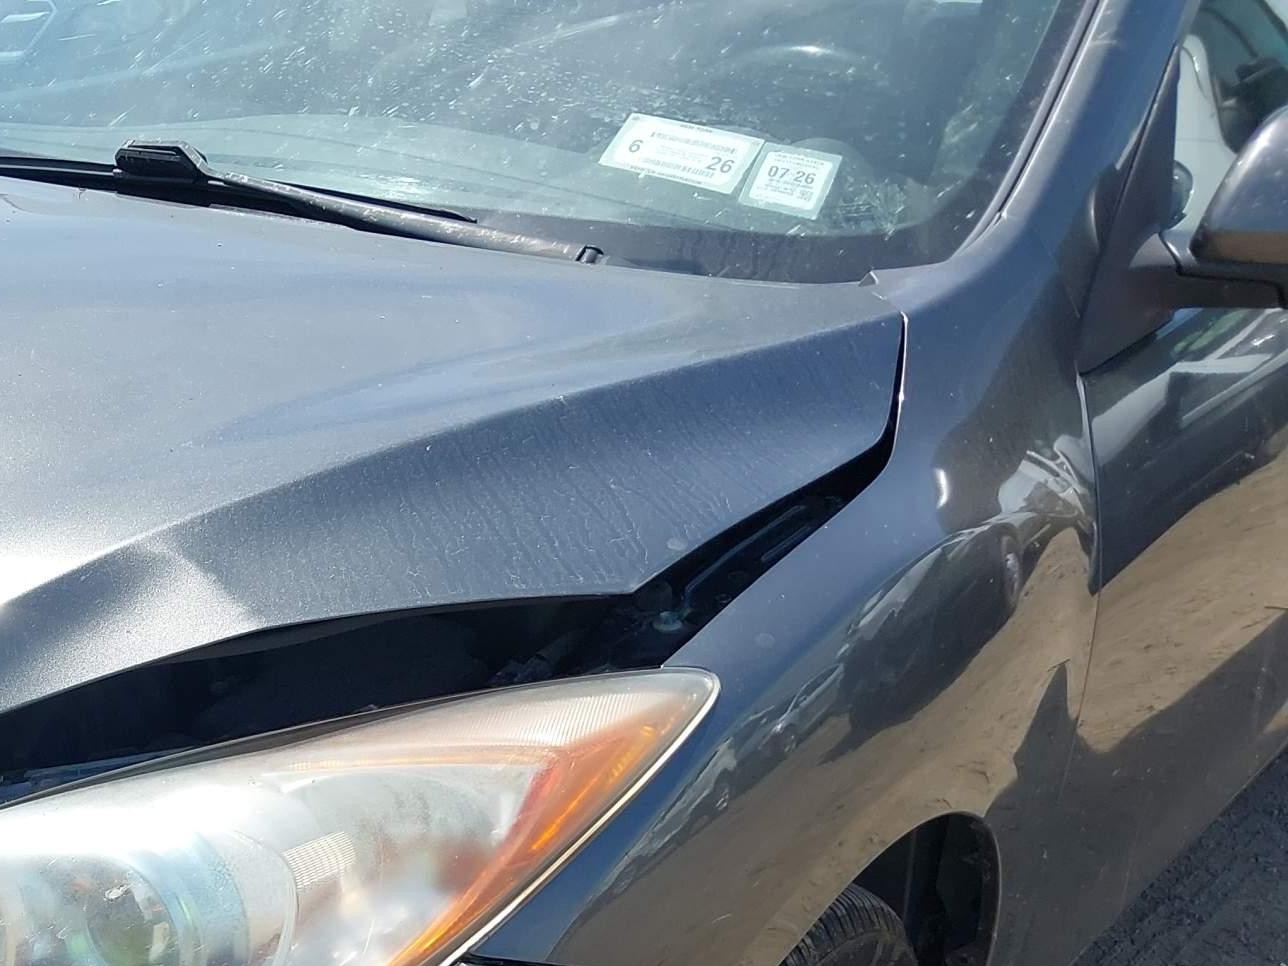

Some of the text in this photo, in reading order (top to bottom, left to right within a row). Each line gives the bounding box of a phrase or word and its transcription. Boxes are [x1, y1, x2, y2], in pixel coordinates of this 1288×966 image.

[628, 139, 735, 174] 6 26
[767, 165, 817, 185] 07 26
